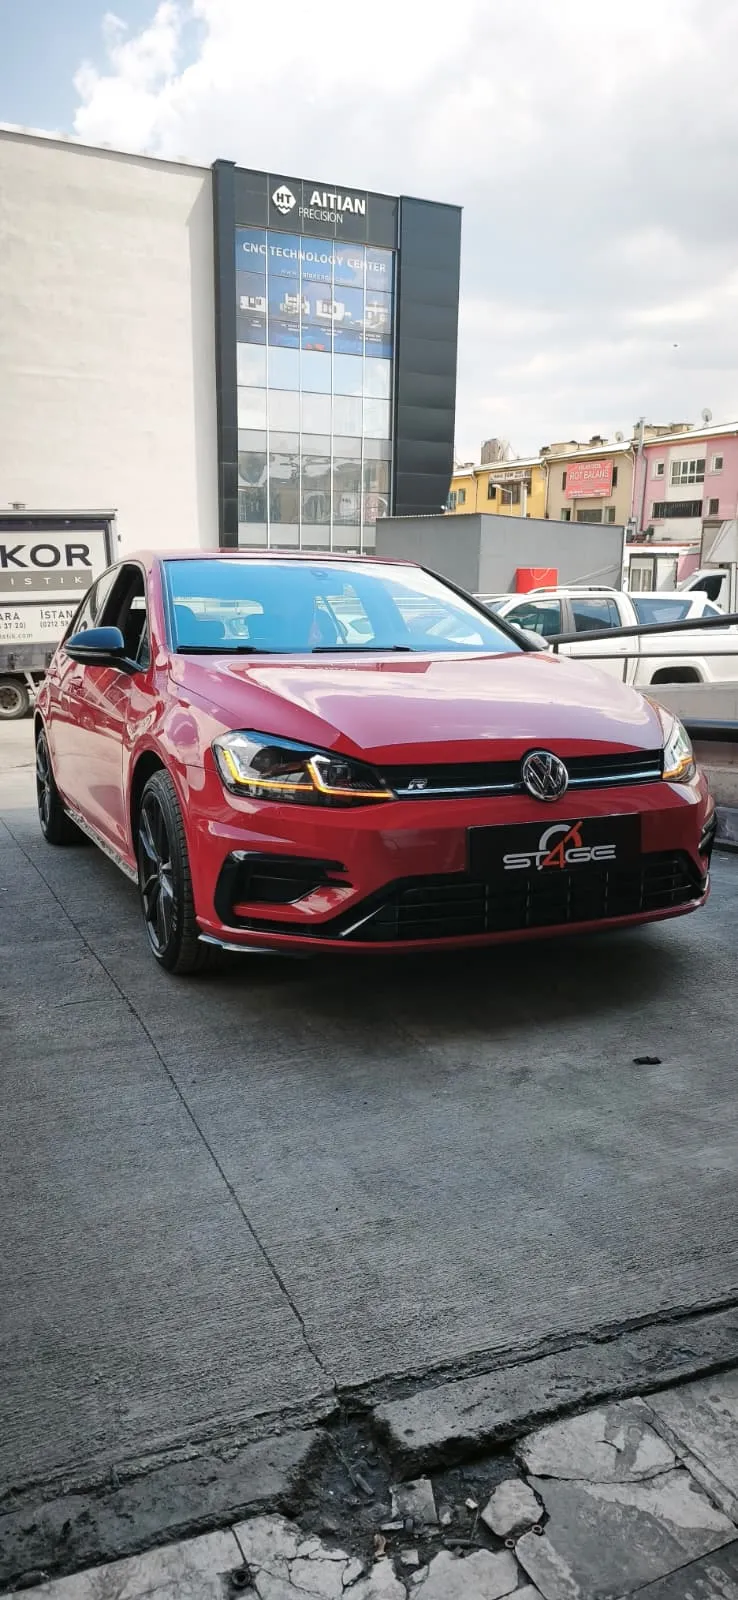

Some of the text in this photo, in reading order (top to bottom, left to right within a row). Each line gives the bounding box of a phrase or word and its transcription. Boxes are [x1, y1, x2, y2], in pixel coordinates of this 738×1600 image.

[276, 191, 366, 215] HT AITIAN
[298, 207, 343, 223] PRECISION
[242, 242, 386, 272] CNC TECHNOLOGY CENTER
